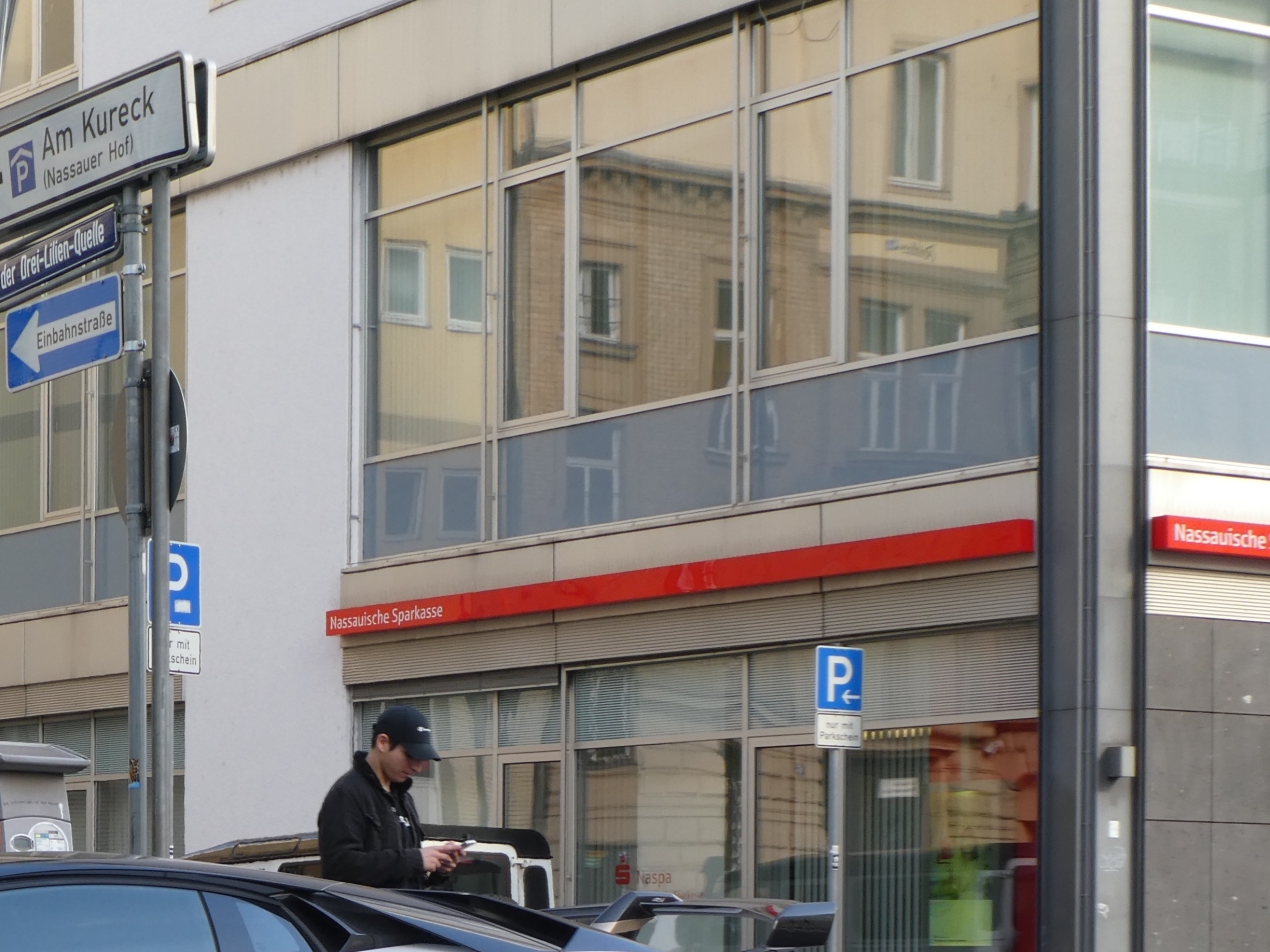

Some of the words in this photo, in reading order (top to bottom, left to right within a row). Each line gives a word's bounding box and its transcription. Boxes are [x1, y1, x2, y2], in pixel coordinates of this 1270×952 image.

[41, 127, 73, 160] Am
[82, 85, 155, 142] Kureck
[43, 151, 103, 190] (Nassauer
[108, 133, 134, 164] Hof)
[0, 265, 16, 288] der
[20, 220, 105, 281] Drei-Lilien-Quelle
[37, 311, 113, 350] Einbahnstraße
[1173, 523, 1268, 549] Nassauische
[330, 610, 390, 630] Nassauische
[391, 605, 443, 625] Sparkasse
[177, 639, 190, 650] mit
[827, 655, 853, 702] P
[820, 730, 859, 742] Parkschein
[636, 870, 672, 887] Naspa
